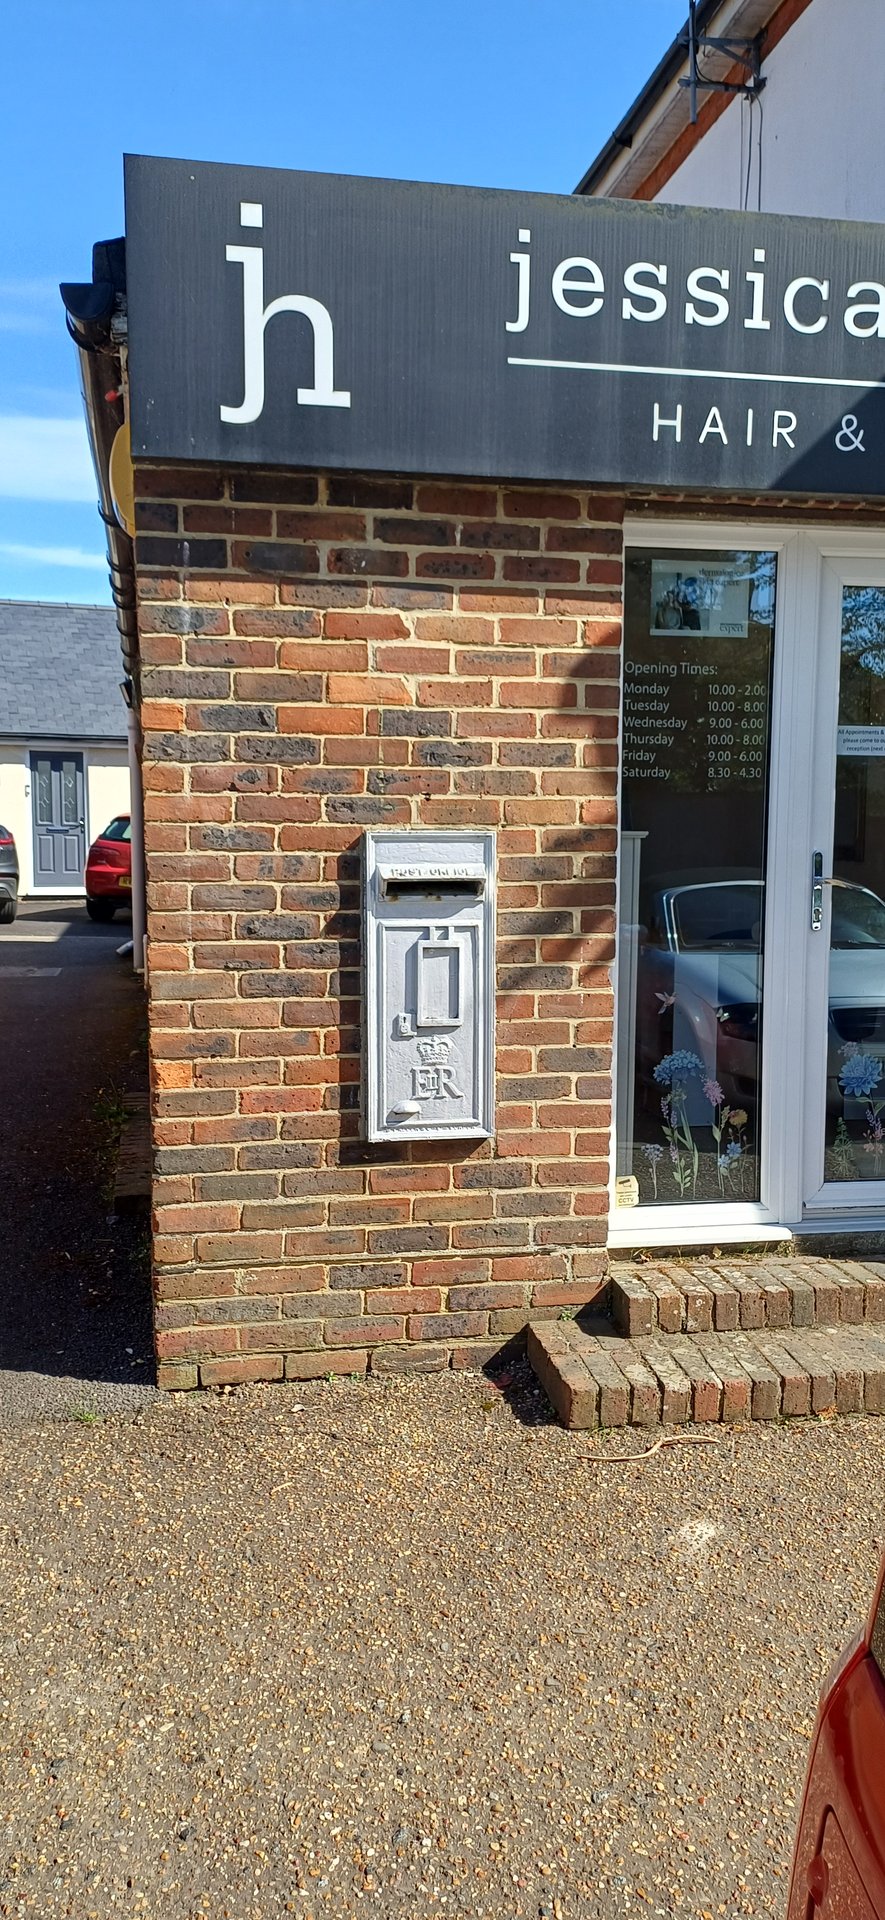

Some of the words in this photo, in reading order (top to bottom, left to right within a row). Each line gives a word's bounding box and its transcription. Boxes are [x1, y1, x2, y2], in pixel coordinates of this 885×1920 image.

[505, 229, 885, 339] jessica
[219, 202, 352, 426] jh
[652, 403, 797, 449] HAIR
[834, 414, 866, 453] &
[624, 661, 678, 677] Opening
[680, 662, 718, 675] Times:
[624, 683, 670, 697] Monday
[708, 684, 736, 696] 10.00
[744, 685, 766, 696] 2.00
[624, 699, 670, 714] Tuesday
[707, 701, 735, 712] 10.00
[743, 702, 766, 713] 8.00
[624, 716, 688, 731] Wednesday
[709, 718, 732, 729] 9.00
[741, 718, 764, 729] 6.00
[624, 733, 674, 747] Thursday
[706, 734, 734, 745] 10.00
[742, 735, 765, 745] 8.00
[622, 750, 656, 764] Friday
[708, 751, 731, 762] 9.00
[740, 751, 762, 762] 6.00
[622, 766, 671, 780] Saturday
[707, 767, 731, 778] 8.30
[739, 767, 762, 778] 4.30
